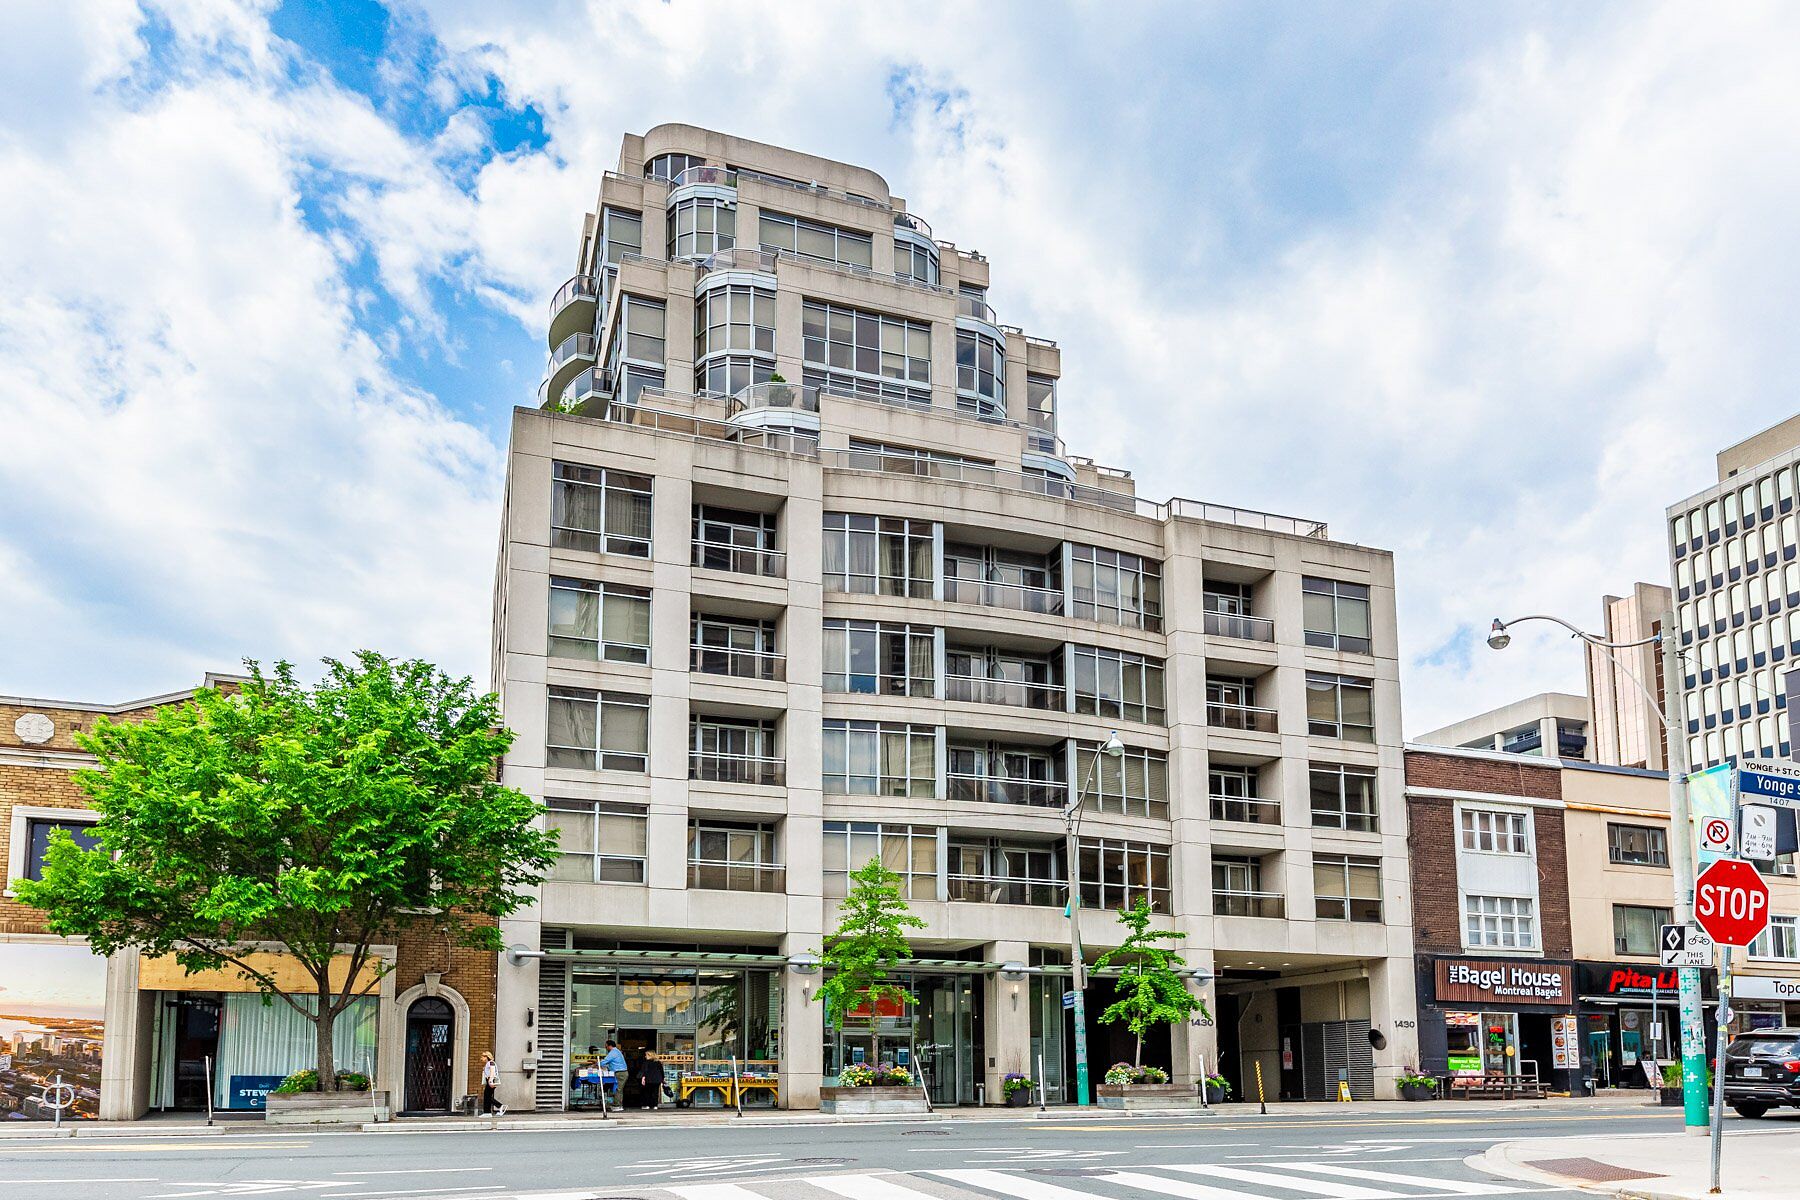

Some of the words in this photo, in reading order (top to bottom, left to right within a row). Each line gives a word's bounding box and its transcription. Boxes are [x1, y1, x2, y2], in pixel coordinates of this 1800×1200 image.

[1745, 762, 1773, 772] YONGE
[1782, 767, 1793, 776] ST.
[1756, 775, 1794, 796] Yonge
[1769, 797, 1790, 806] 1407
[1699, 884, 1765, 921] STOP
[1449, 965, 1458, 984] THE
[1458, 965, 1505, 989] Bagel
[1511, 968, 1562, 987] House
[1608, 967, 1652, 993] Pita
[1494, 986, 1533, 996] Montreal
[1534, 987, 1562, 999] Bagels
[1191, 1018, 1214, 1027] 1430
[1394, 1020, 1415, 1029] 1430
